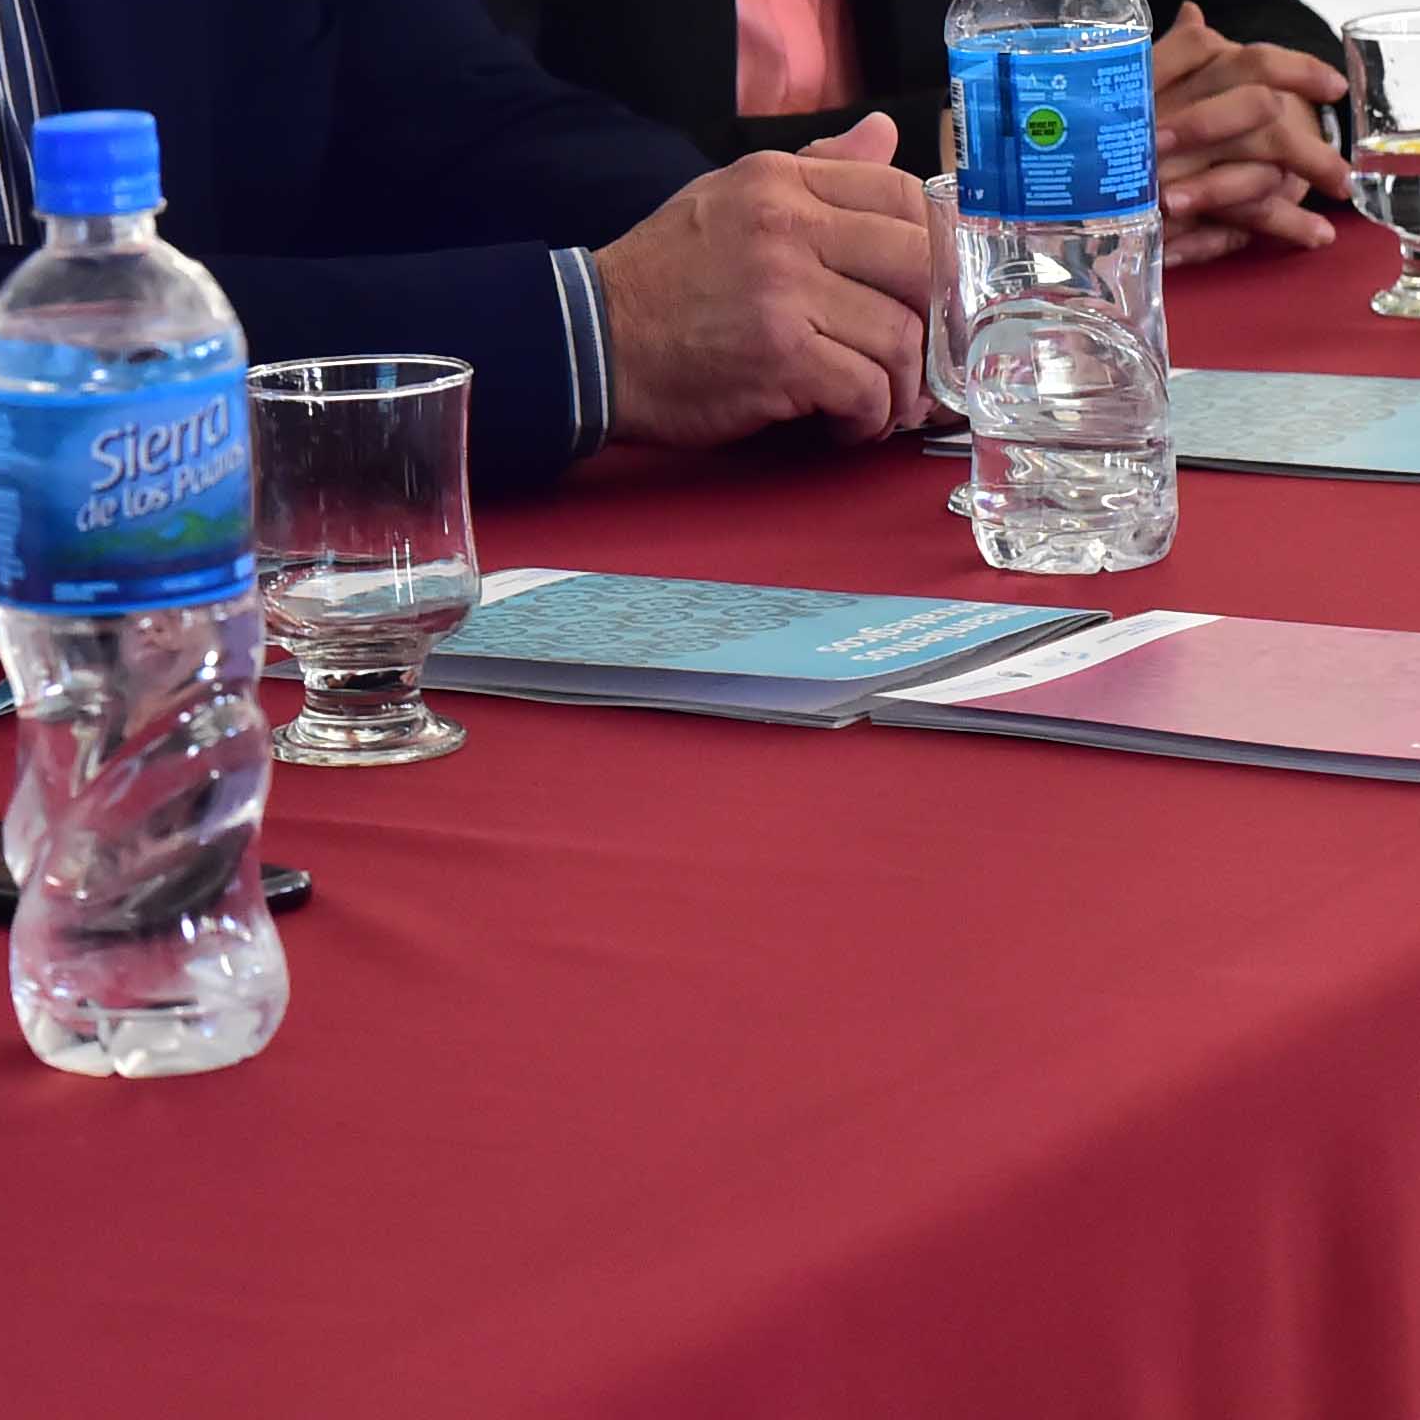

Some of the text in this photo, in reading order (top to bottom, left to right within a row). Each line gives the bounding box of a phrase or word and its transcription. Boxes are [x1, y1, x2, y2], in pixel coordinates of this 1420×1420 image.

[91, 394, 230, 492] Sierra
[76, 494, 118, 531] de
[123, 484, 169, 518] los
[816, 602, 995, 653] stratégicos
[850, 605, 1036, 661] neamientos
